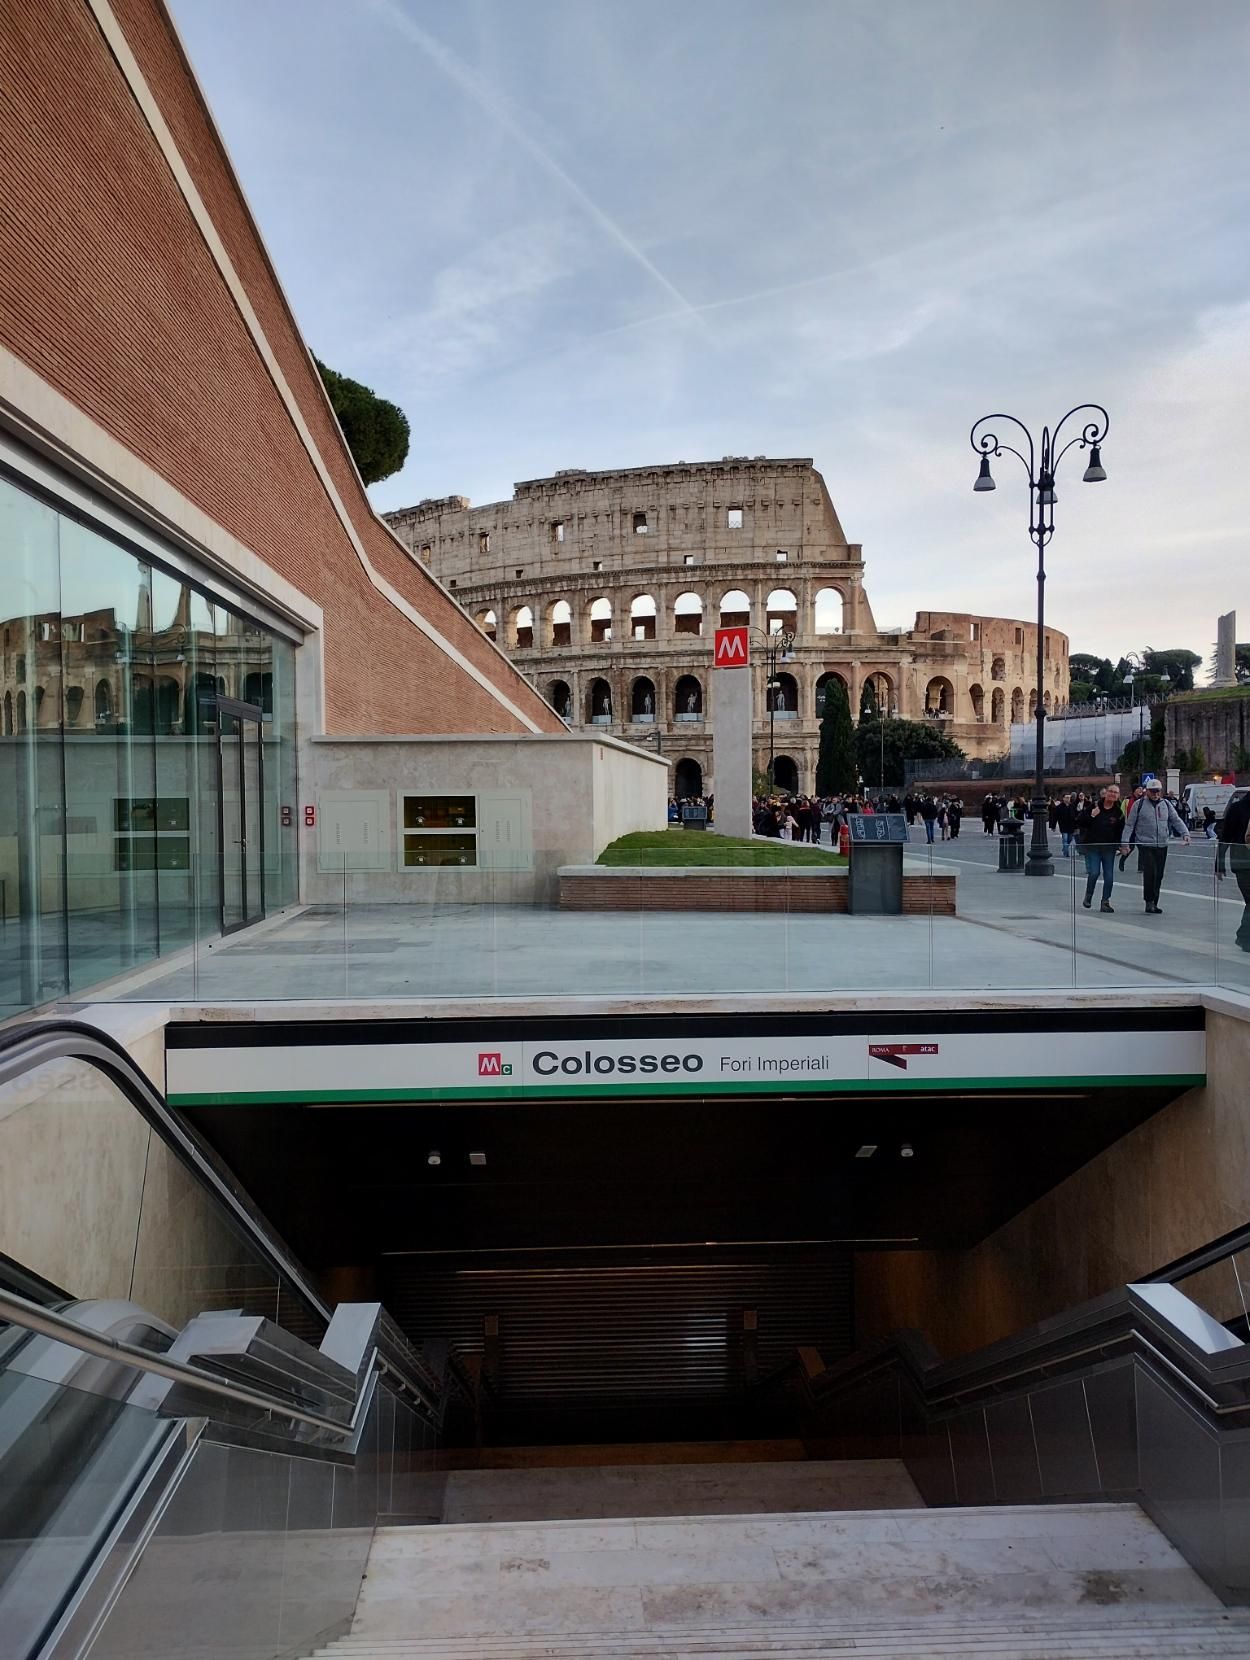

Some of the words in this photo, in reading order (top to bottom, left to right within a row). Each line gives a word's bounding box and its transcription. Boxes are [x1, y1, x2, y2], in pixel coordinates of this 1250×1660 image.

[718, 635, 745, 659] M
[480, 1057, 500, 1073] M
[532, 1051, 704, 1076] Colosseo
[720, 1056, 752, 1072] Fori
[758, 1055, 830, 1075] Imperiali
